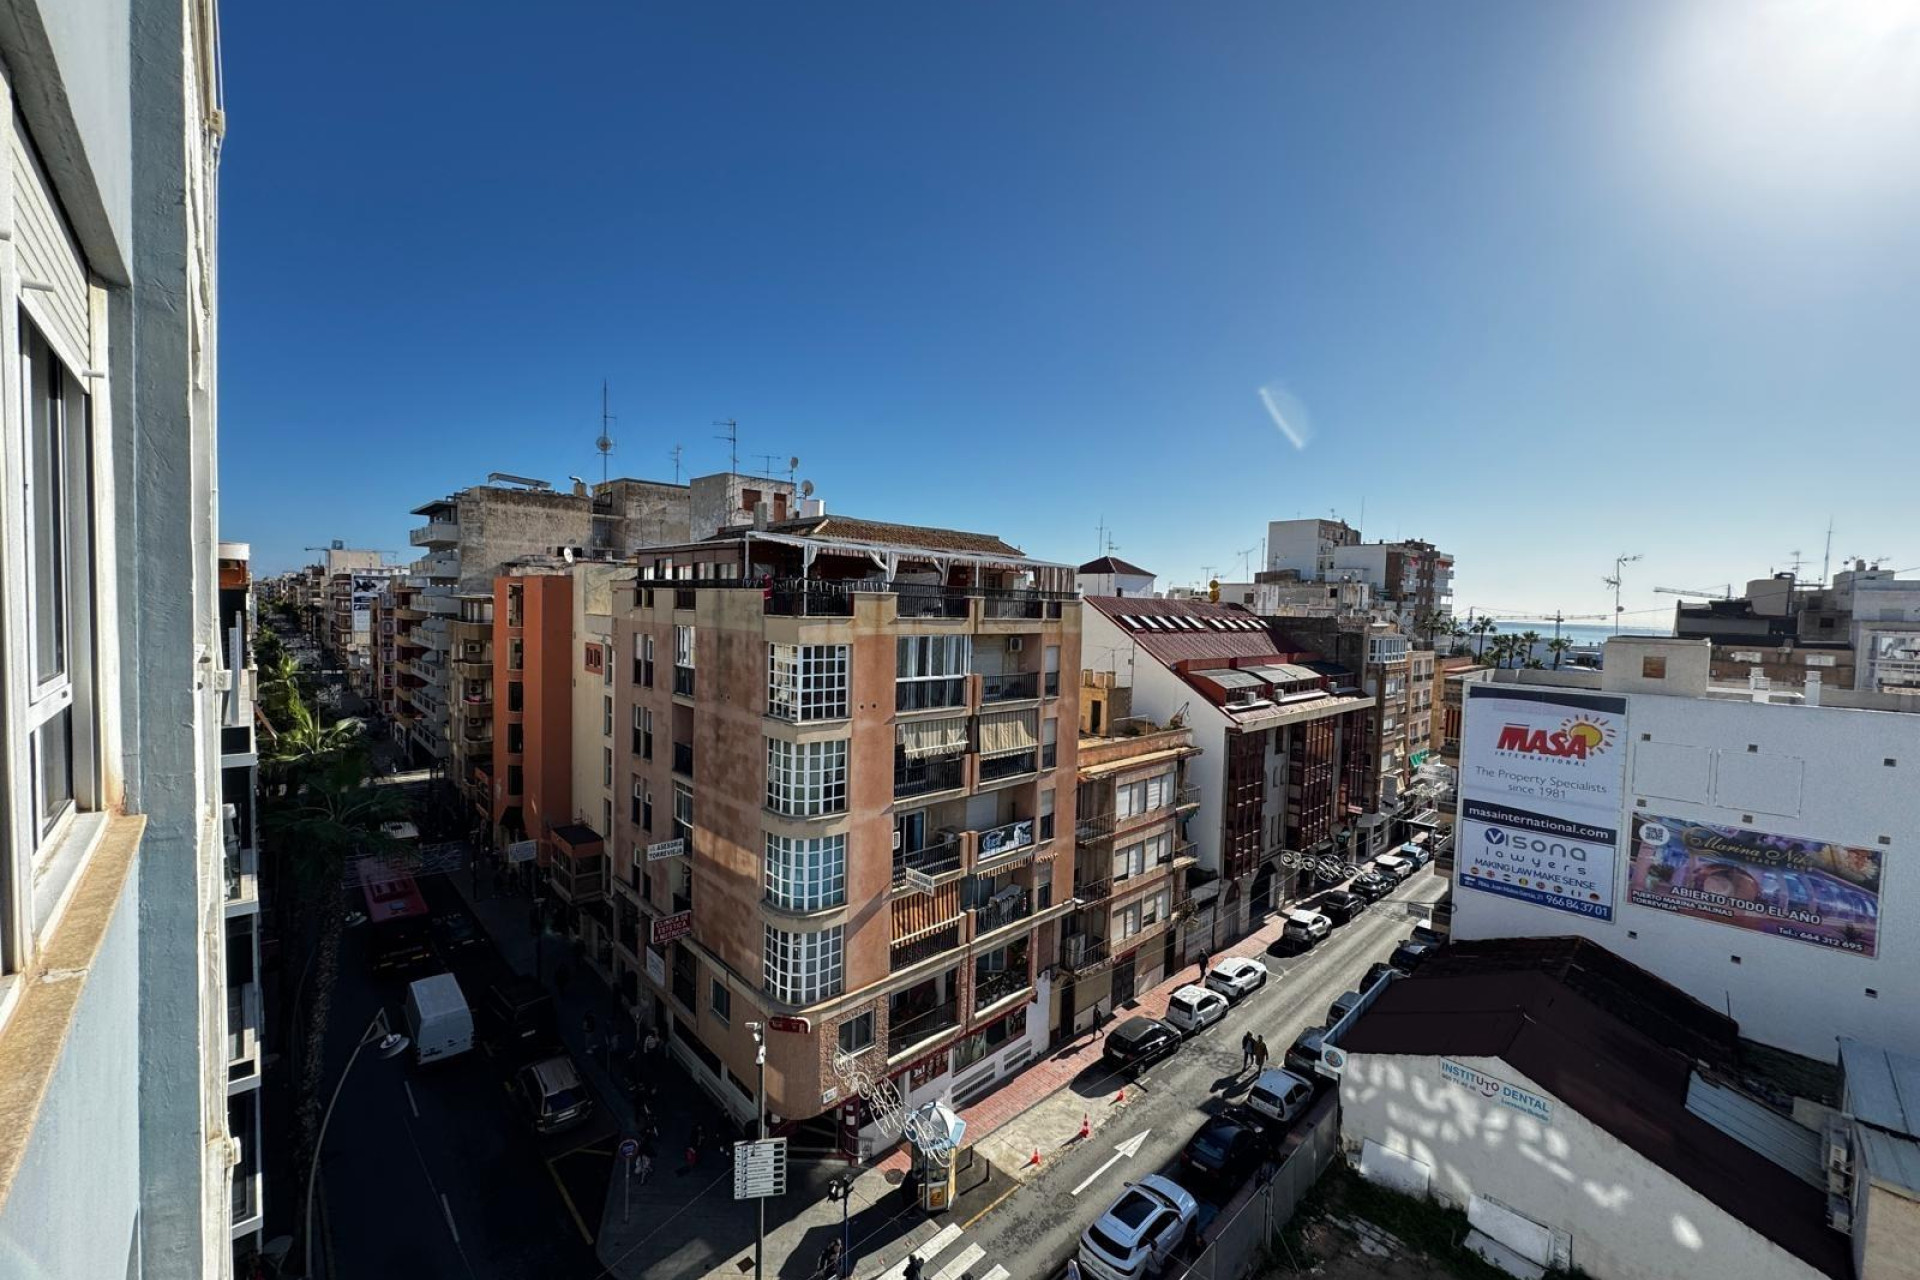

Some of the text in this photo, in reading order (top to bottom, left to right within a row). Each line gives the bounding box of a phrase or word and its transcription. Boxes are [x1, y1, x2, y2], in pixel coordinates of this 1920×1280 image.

[1497, 725, 1587, 760] MASA
[1494, 751, 1587, 767] INTERNATIONAL
[1476, 765, 1607, 793] The Property Specialists
[1508, 784, 1566, 799] since 1981
[1469, 806, 1609, 839] masainternational.com
[1690, 836, 1760, 857] Marina
[1475, 857, 1596, 890] MAKING LAW MAKE SENSE
[1485, 846, 1587, 876] lawyers
[1547, 894, 1608, 917] 966 84 37 01
[1632, 890, 1733, 917] PUERTO MARINA SALINAS
[1632, 896, 1678, 911] TORREVIEJA
[1671, 886, 1820, 924] ABIERTO TODO EL AÑO
[1799, 932, 1820, 941] 664
[1822, 937, 1839, 946] 312
[1841, 940, 1864, 951] 695
[1441, 1062, 1500, 1092] INSTITUTO
[1503, 1086, 1549, 1113] DENTAL
